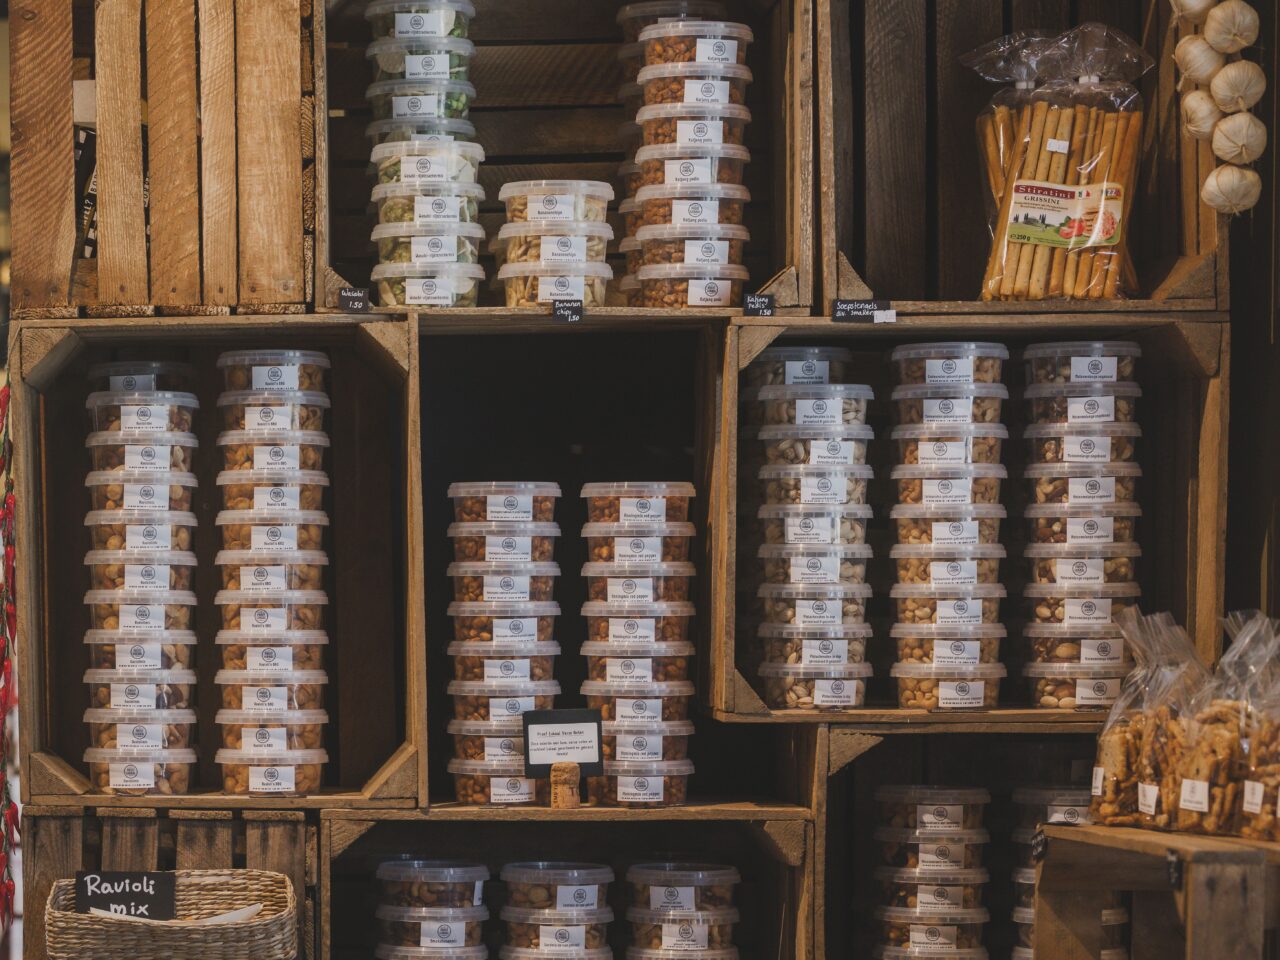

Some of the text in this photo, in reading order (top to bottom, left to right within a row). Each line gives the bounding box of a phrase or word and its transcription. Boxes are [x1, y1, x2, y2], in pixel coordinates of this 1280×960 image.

[1018, 185, 1073, 199] Stiratini
[1024, 195, 1060, 205] GRISSINI
[348, 300, 364, 309] 1.50
[84, 874, 155, 896] Ravioli
[109, 902, 149, 916] mix
